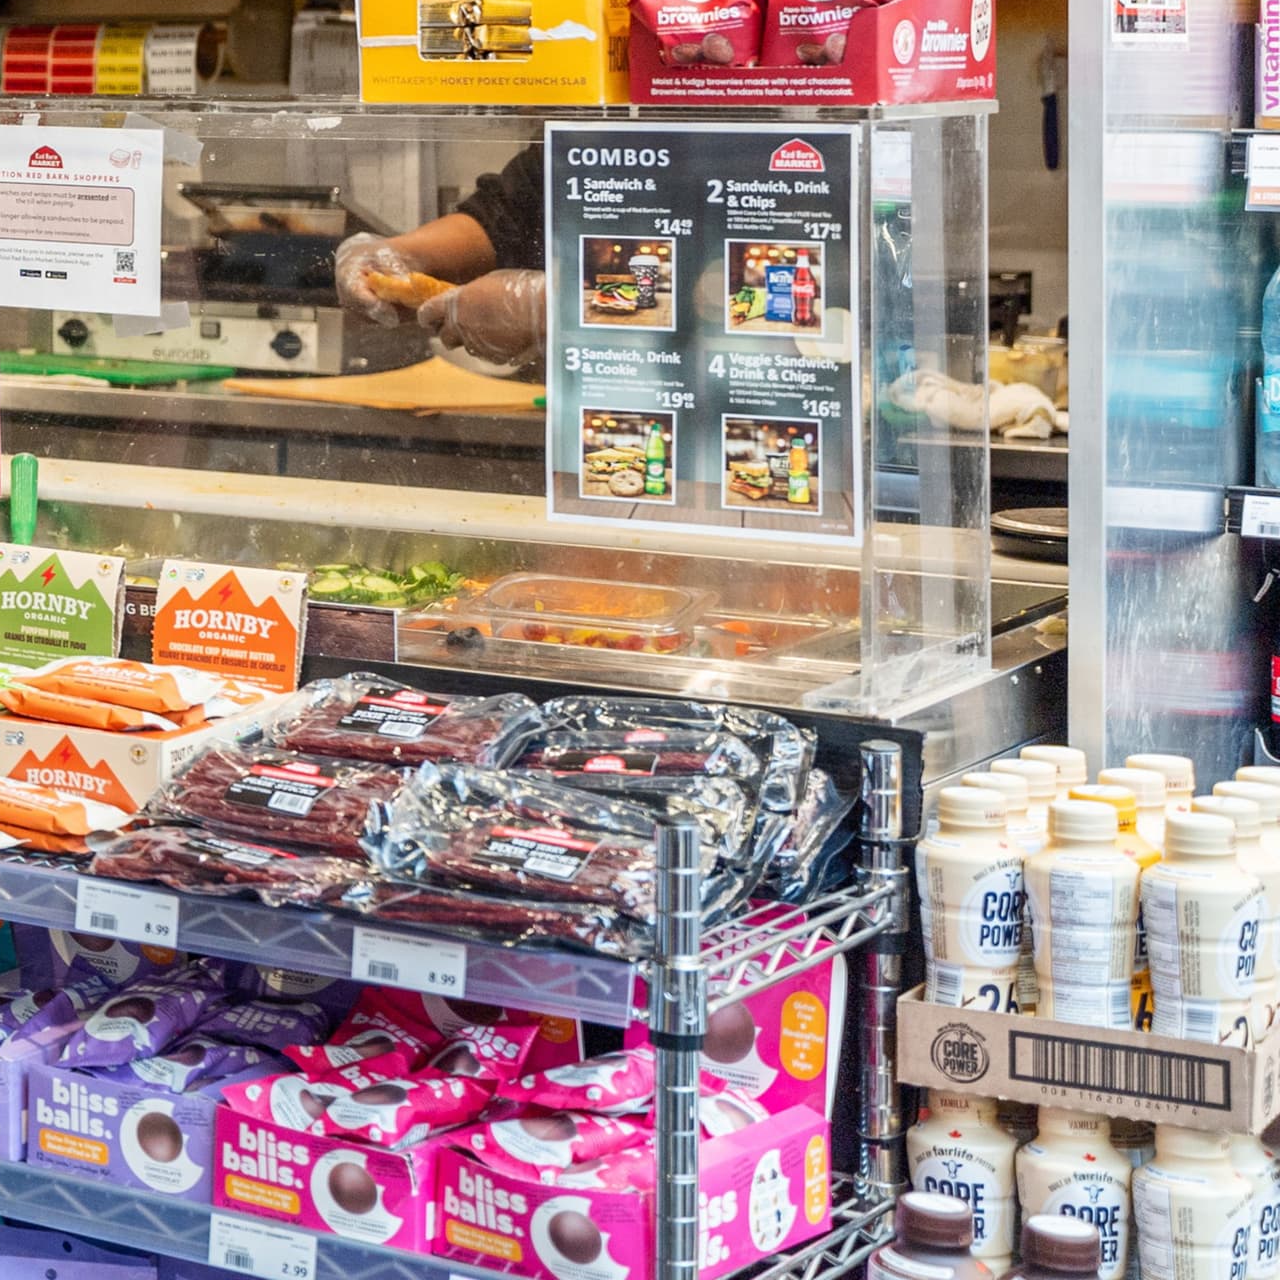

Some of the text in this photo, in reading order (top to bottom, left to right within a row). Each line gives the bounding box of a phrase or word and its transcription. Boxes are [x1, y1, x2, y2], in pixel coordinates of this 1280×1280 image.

[440, 75, 474, 87] HOKEY
[477, 76, 511, 87] POKEY
[513, 76, 555, 87] CRUNCH
[557, 76, 587, 88] SLAB
[567, 147, 671, 167] COMBOS
[566, 177, 657, 201] 1 Sandwich &
[583, 191, 624, 204] Coffee
[706, 179, 830, 204] 2 Sandwich, Drink
[727, 195, 777, 209] & Chips
[174, 608, 276, 640] HORNBY
[198, 630, 246, 644] ORGANIC
[144, 921, 171, 937] 8.99
[943, 1040, 979, 1062] CORE
[942, 1056, 981, 1075] POWER
[458, 1167, 528, 1215] bliss
[443, 1188, 524, 1240] balls.
